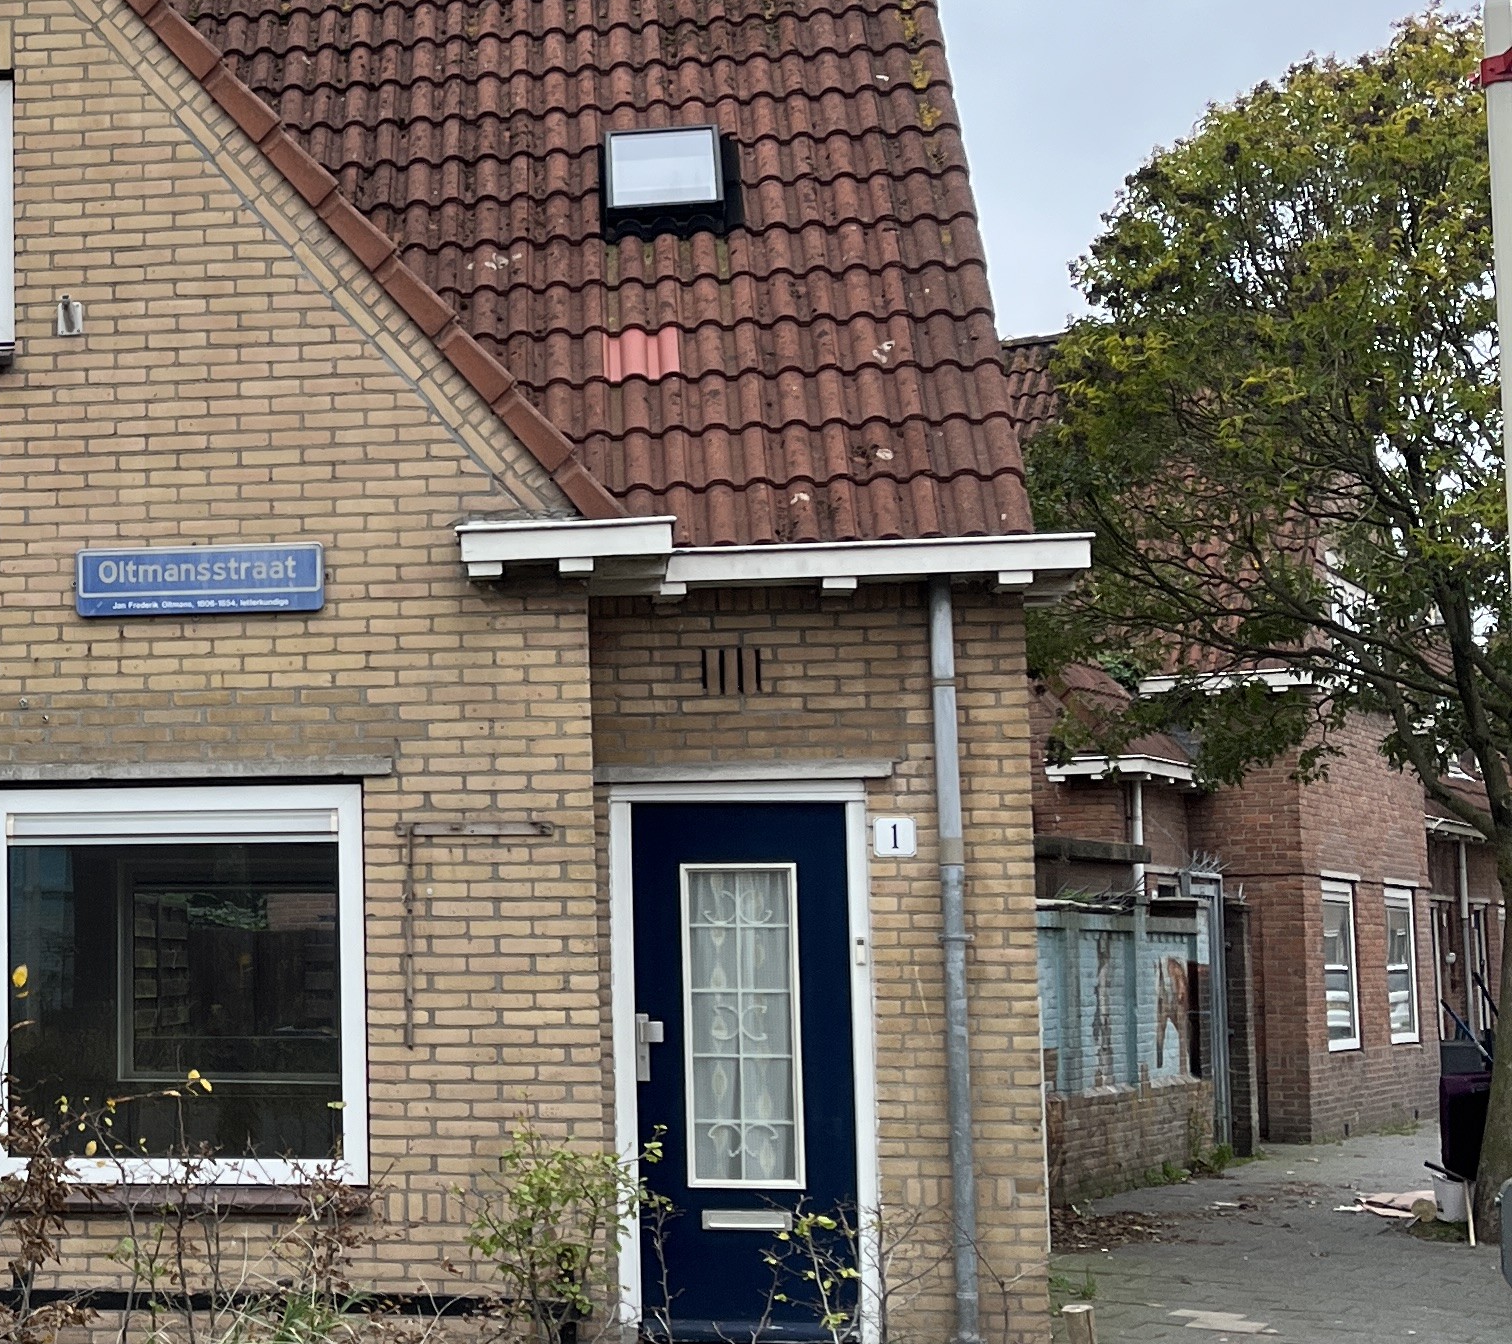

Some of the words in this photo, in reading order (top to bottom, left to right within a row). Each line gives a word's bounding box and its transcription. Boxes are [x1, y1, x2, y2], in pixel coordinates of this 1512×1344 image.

[98, 556, 296, 584] Oltmansstraat
[112, 601, 127, 610] Jan
[891, 823, 899, 849] 1
